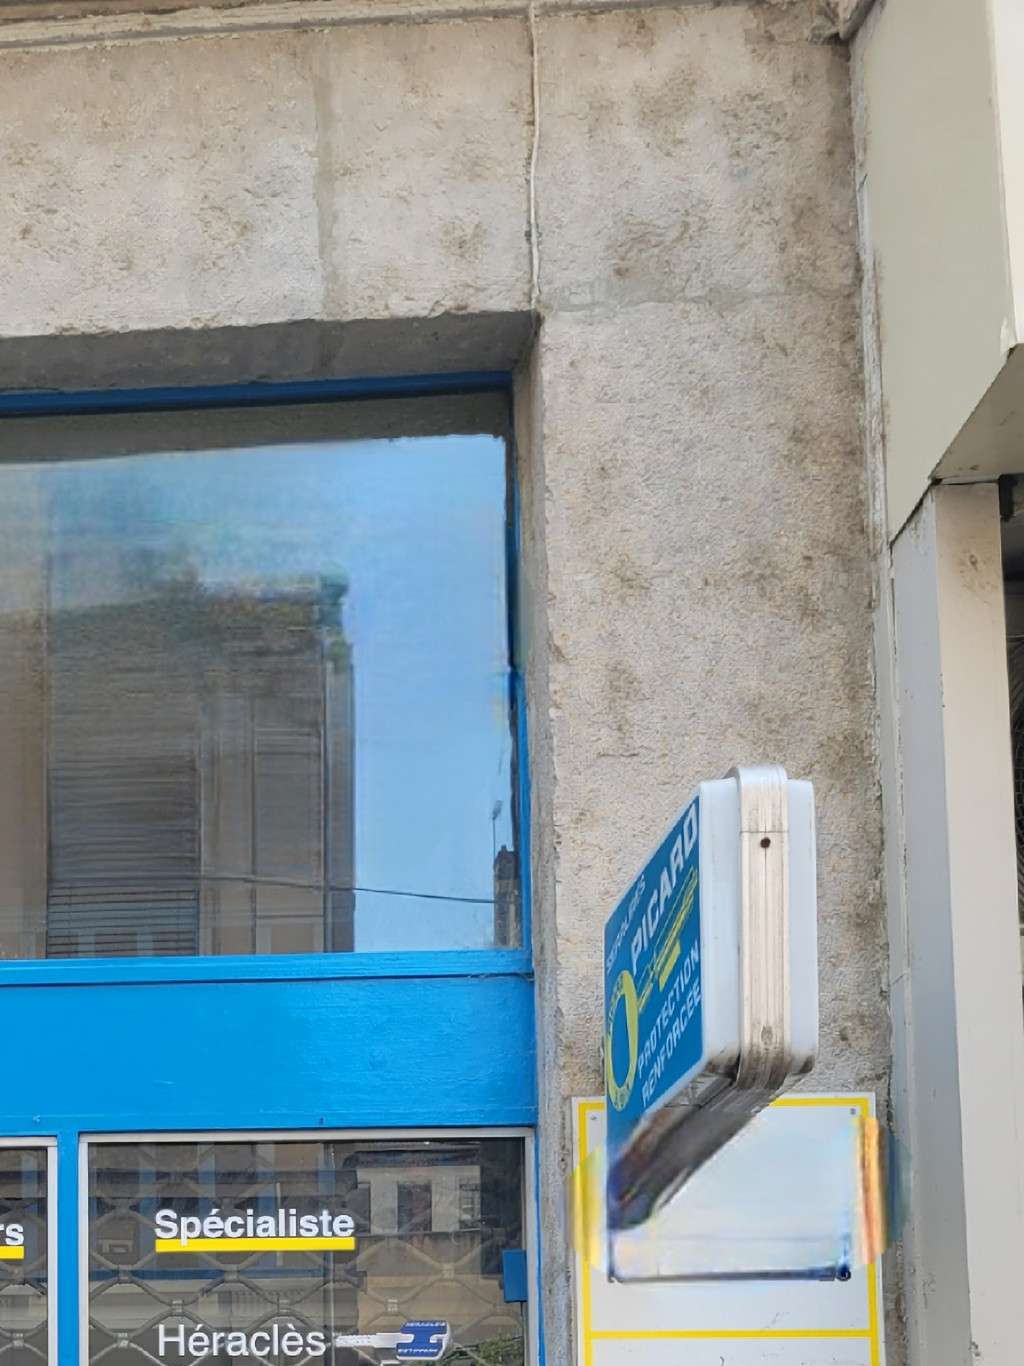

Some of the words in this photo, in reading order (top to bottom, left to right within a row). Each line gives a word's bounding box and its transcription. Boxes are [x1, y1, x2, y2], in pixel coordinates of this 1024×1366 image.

[631, 803, 697, 976] PICARD
[638, 942, 699, 1079] PROTECTION
[154, 1208, 355, 1247] Spécialiste
[159, 1324, 326, 1357] Héraclès
